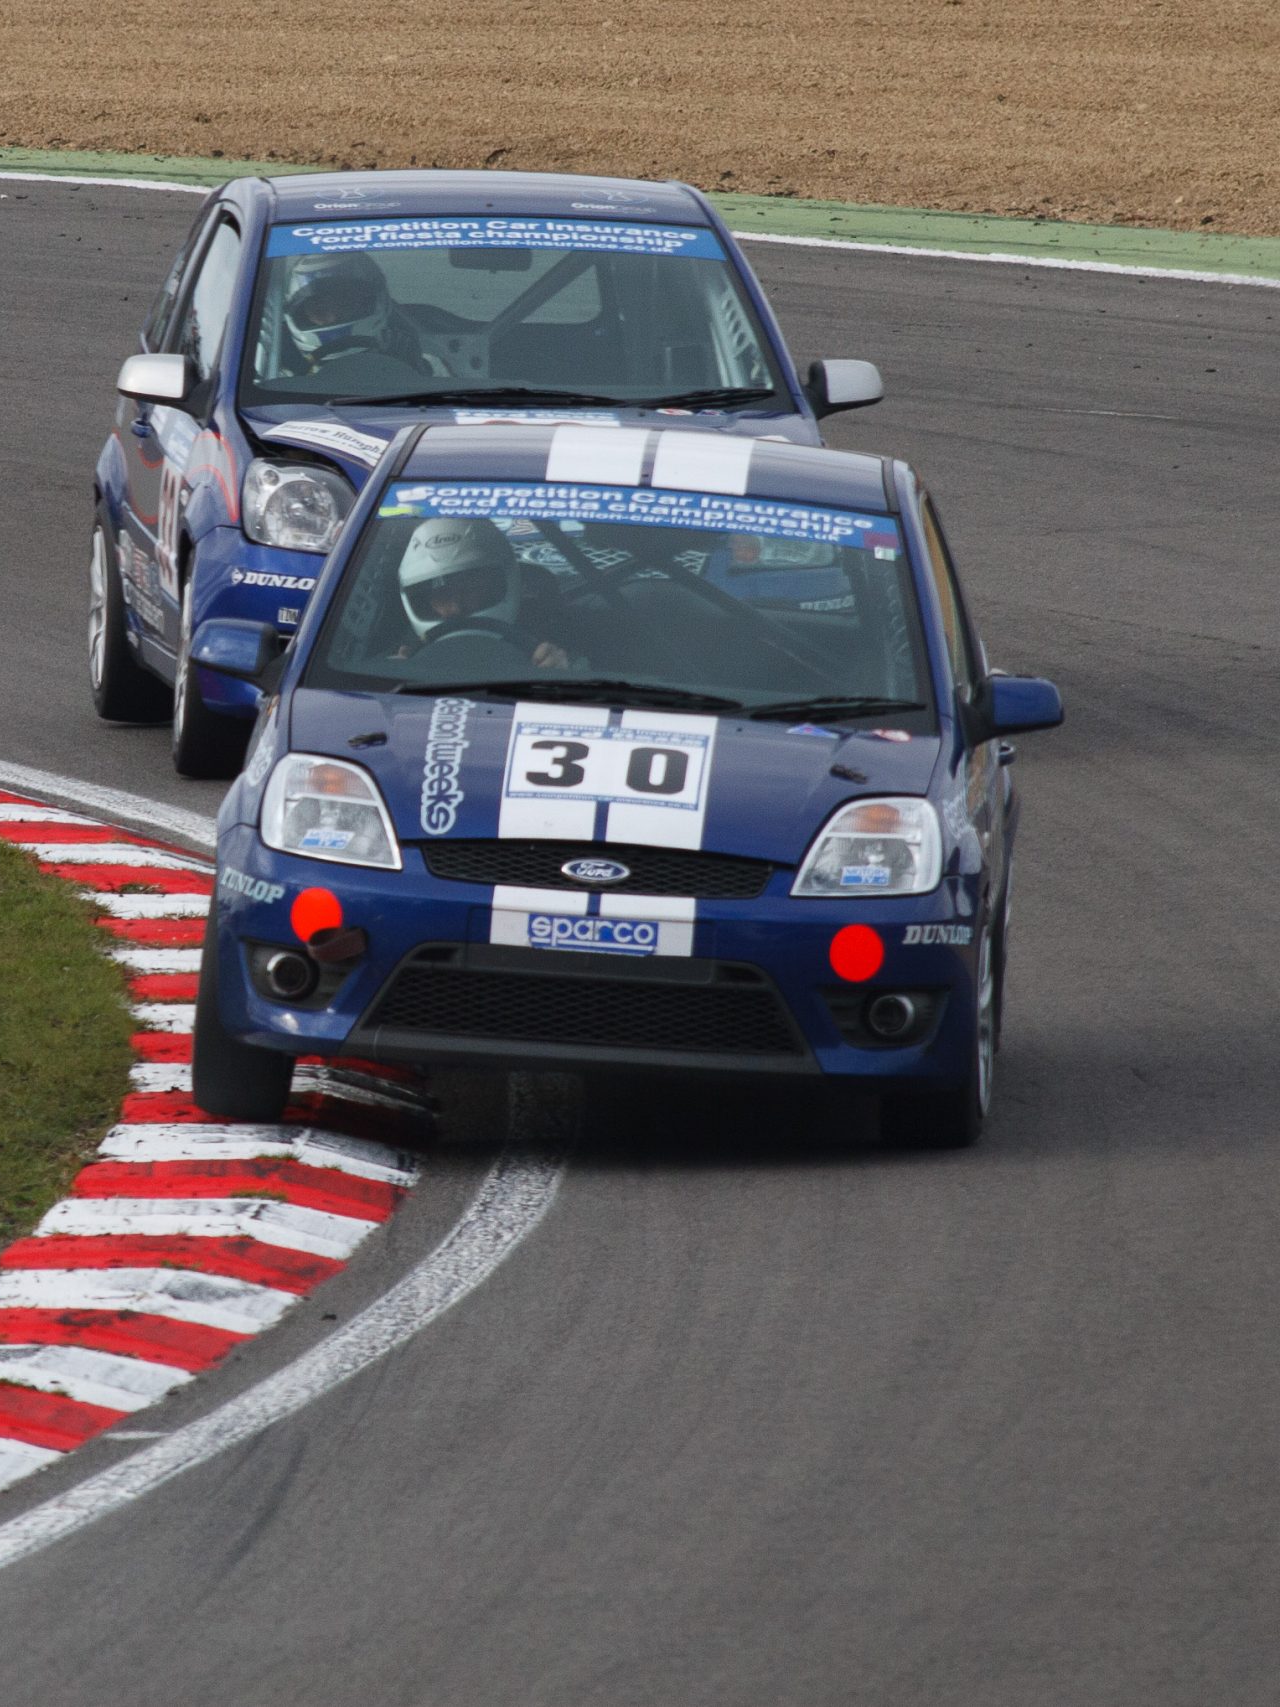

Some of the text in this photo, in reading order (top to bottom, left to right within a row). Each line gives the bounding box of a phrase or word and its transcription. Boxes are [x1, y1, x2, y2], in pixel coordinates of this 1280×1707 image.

[292, 220, 697, 241] Competition Car Insurance
[311, 229, 684, 248] ford fiesta championship
[429, 496, 854, 537] ford fiesta championship
[631, 492, 693, 506] Car
[700, 497, 873, 529] Insurance
[242, 571, 317, 591] DUNLO
[576, 861, 615, 878] Ford
[530, 915, 655, 947] sparco
[902, 924, 972, 945] DUNLOP
